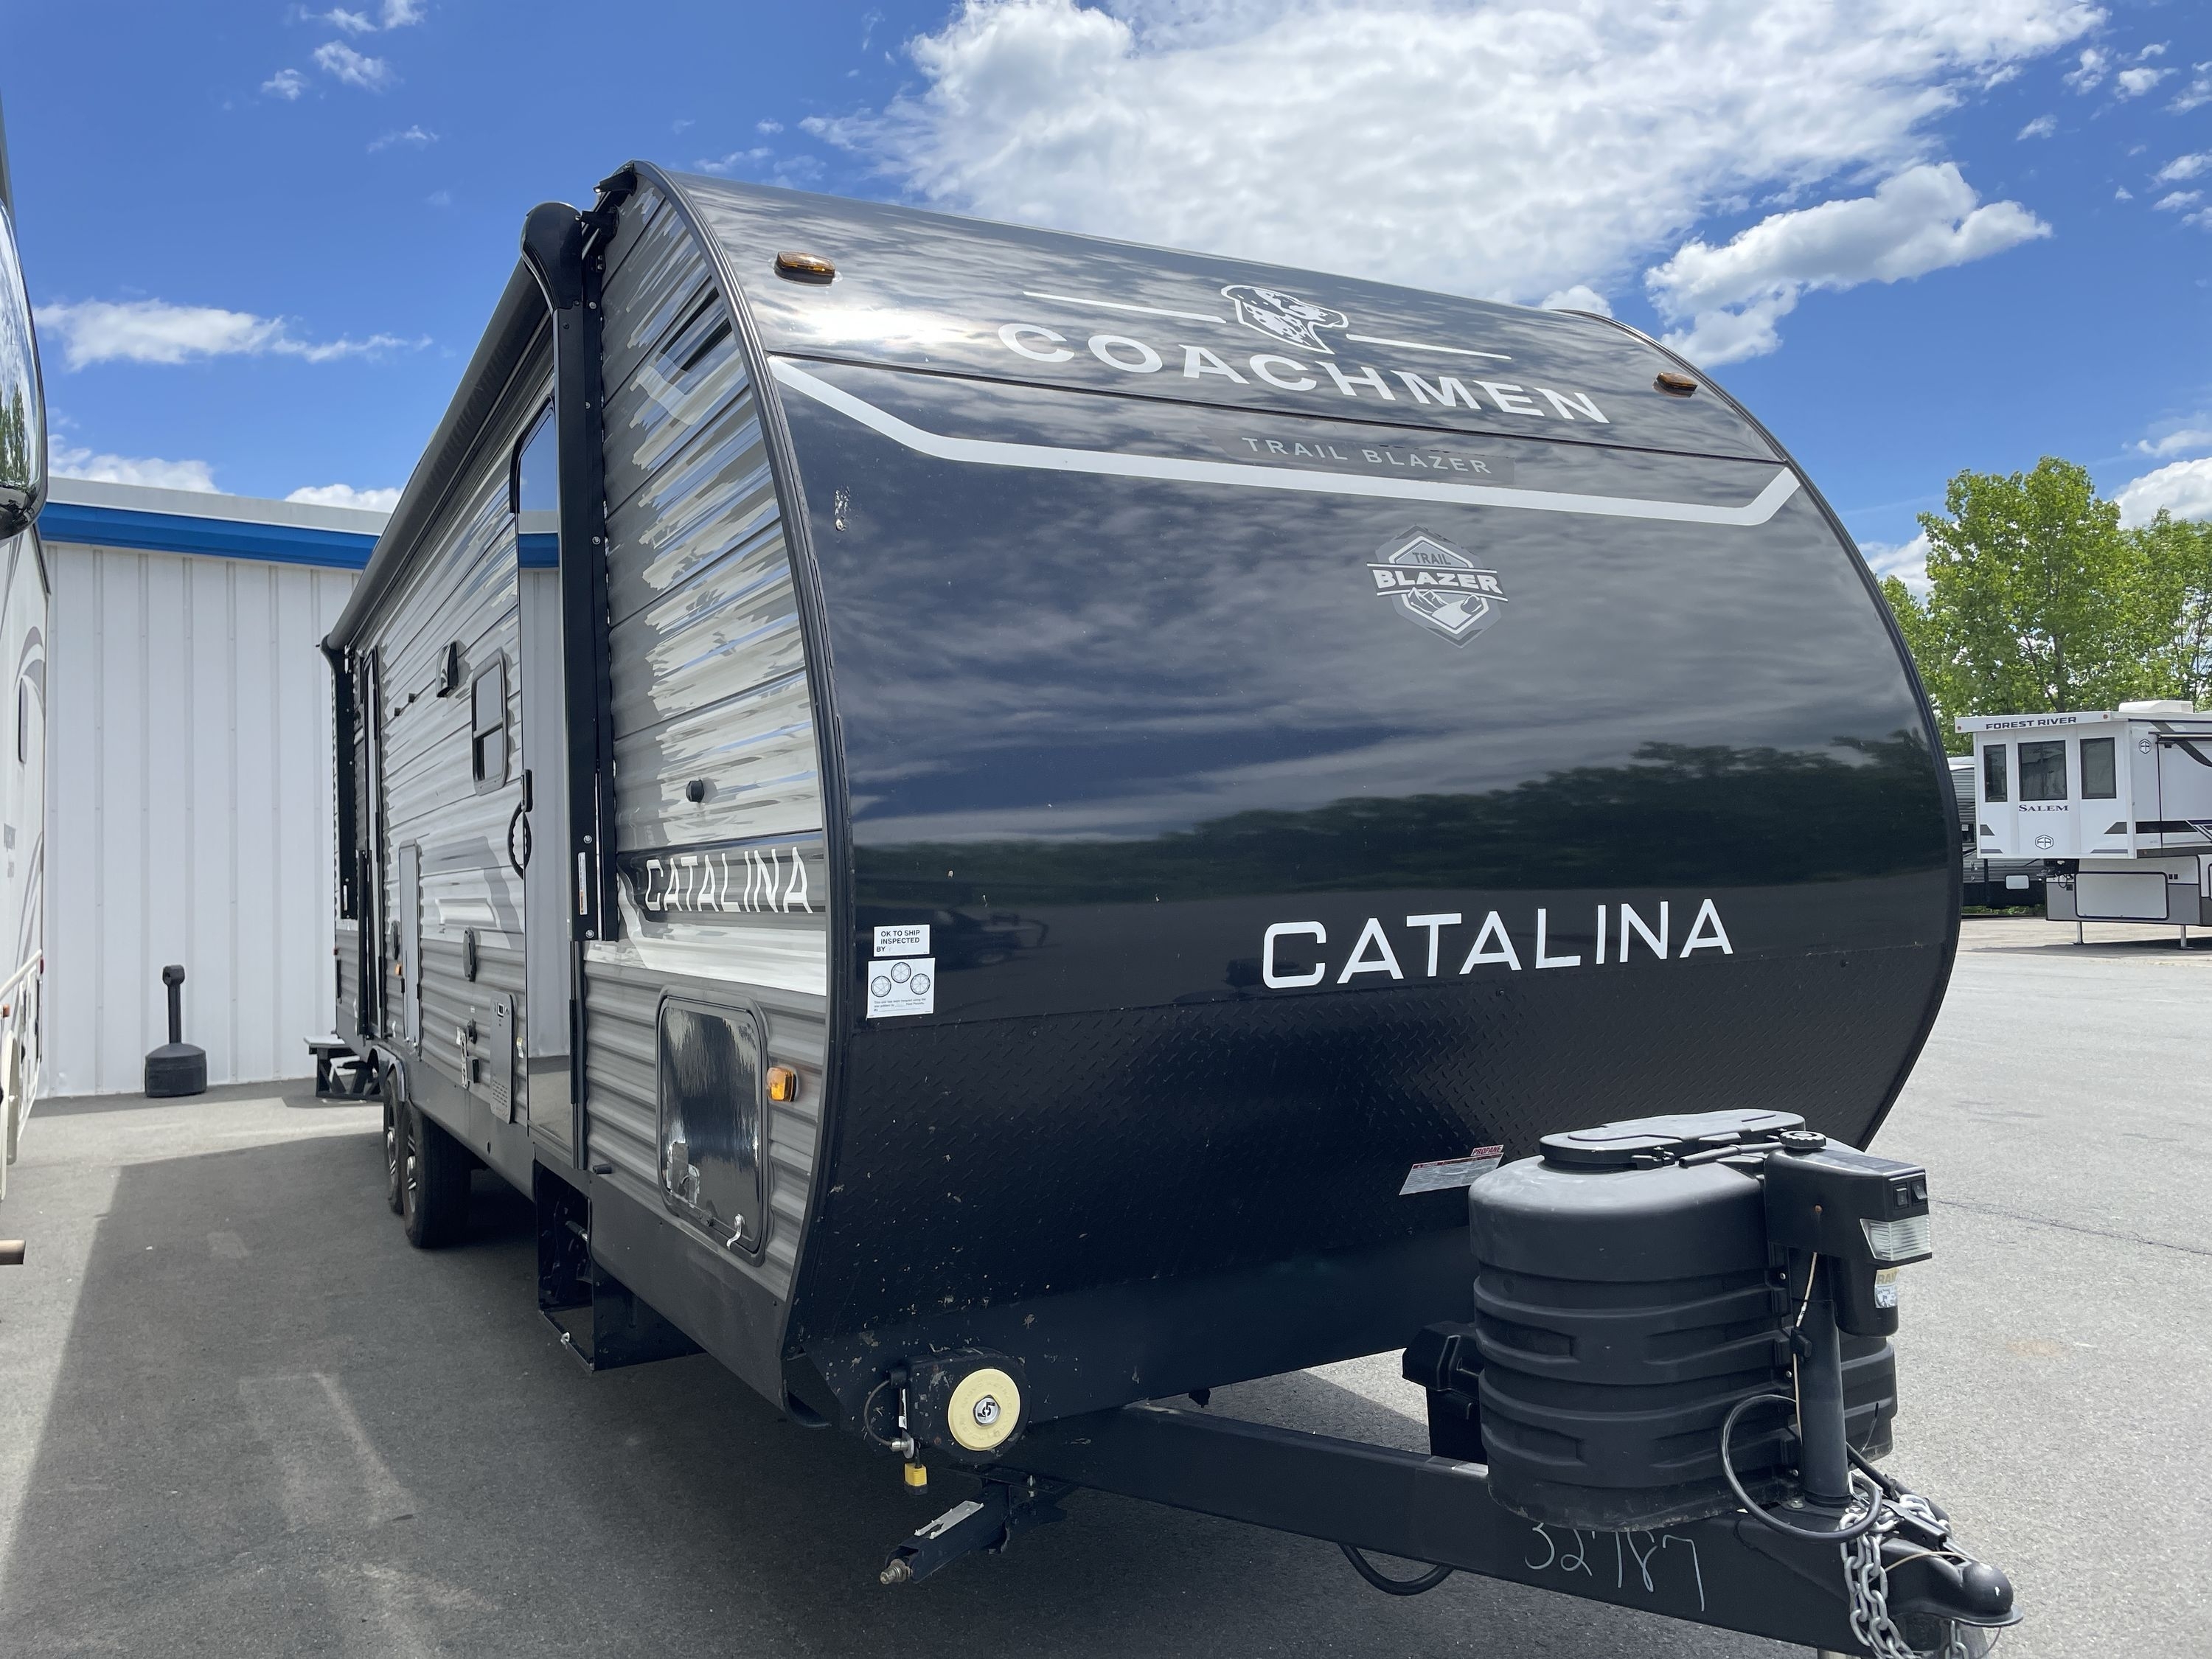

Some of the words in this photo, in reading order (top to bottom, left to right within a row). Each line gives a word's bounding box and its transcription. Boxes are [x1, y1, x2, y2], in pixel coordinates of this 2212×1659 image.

[998, 322, 1610, 424] COACHMEN
[1241, 437, 1349, 461] TRAIL
[1361, 448, 1493, 474] BLAZER
[1412, 552, 1452, 566] TRAIL
[1372, 569, 1503, 594] BLAZER
[1985, 720, 2034, 730] FOREST
[2037, 716, 2077, 726] RIVER
[2018, 804, 2069, 812] SALEM
[644, 846, 814, 914] CATALINA
[880, 936, 920, 945] INSPECTED
[1262, 898, 1734, 990] CATALINA
[1472, 1145, 1503, 1155] PROPANE
